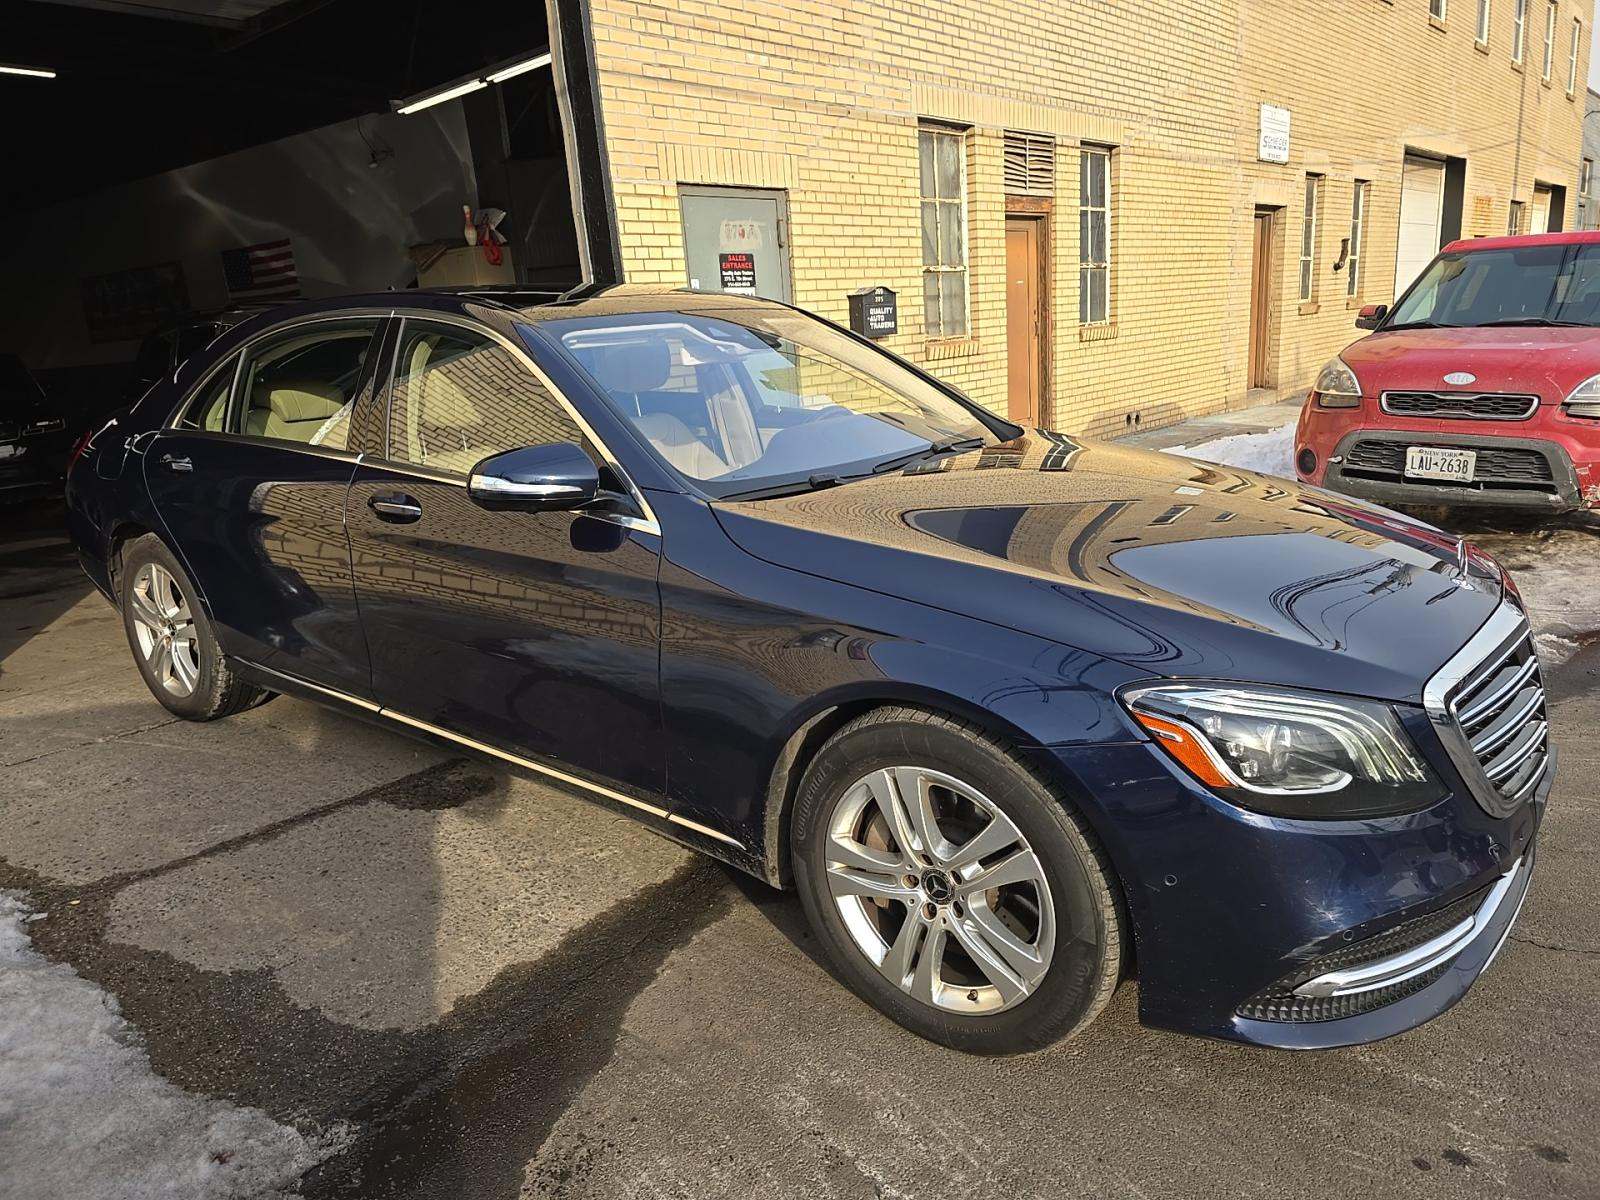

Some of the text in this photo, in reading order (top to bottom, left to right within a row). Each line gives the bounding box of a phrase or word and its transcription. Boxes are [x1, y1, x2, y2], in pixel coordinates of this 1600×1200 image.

[870, 307, 893, 315] QUALITY
[870, 321, 895, 330] TRADERS
[797, 767, 828, 841] Continental
